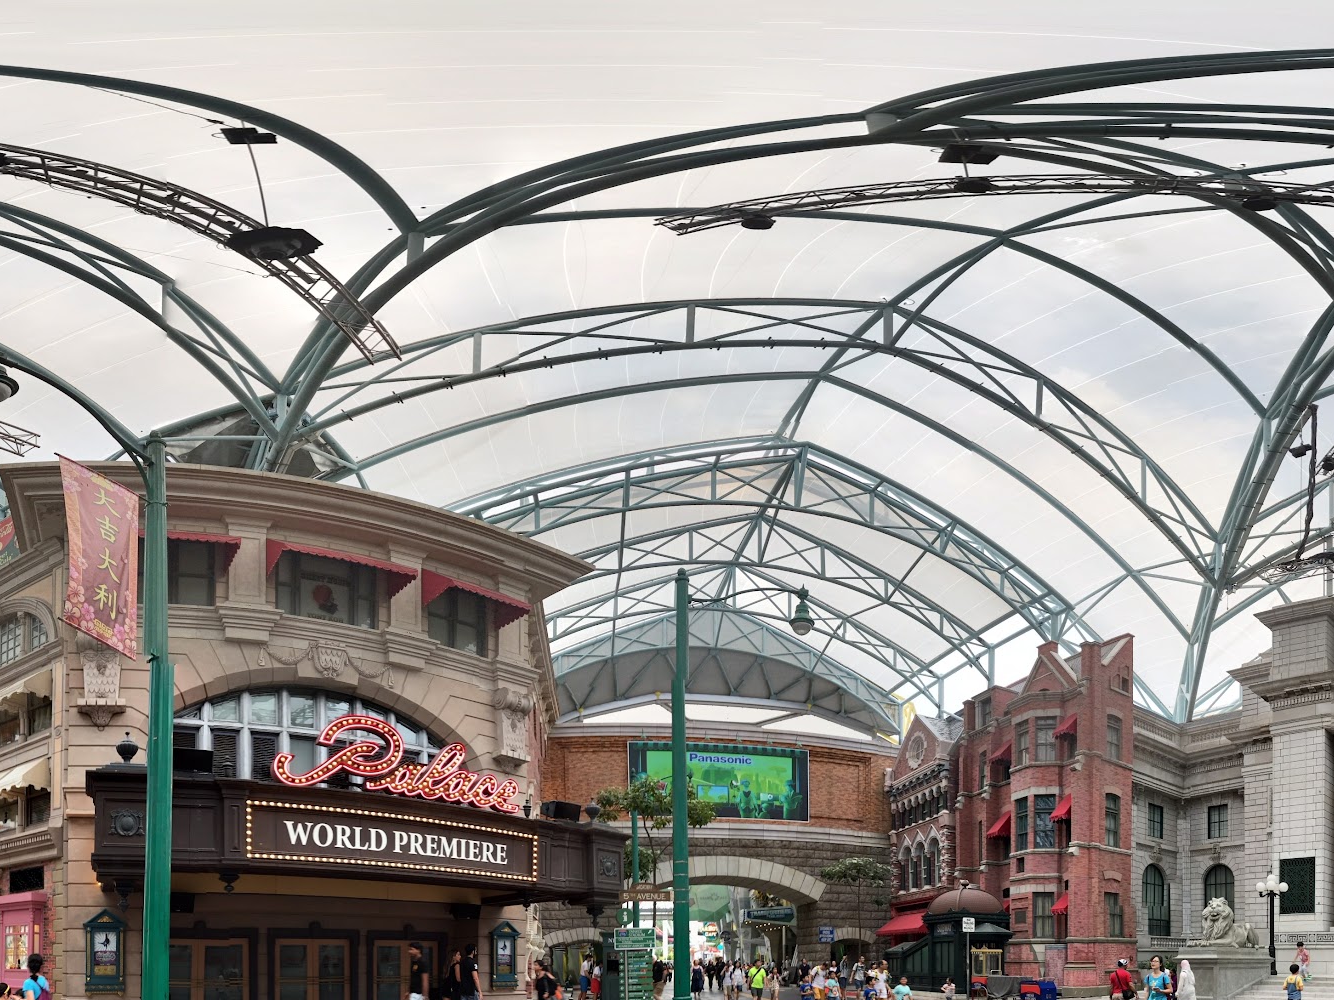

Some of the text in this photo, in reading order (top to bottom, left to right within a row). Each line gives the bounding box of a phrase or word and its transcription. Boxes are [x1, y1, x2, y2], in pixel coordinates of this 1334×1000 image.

[93, 487, 121, 621] 大吉大利
[272, 714, 519, 814] Palace
[689, 752, 752, 765] Panasonic
[283, 820, 508, 865] WORLD PREMIERE
